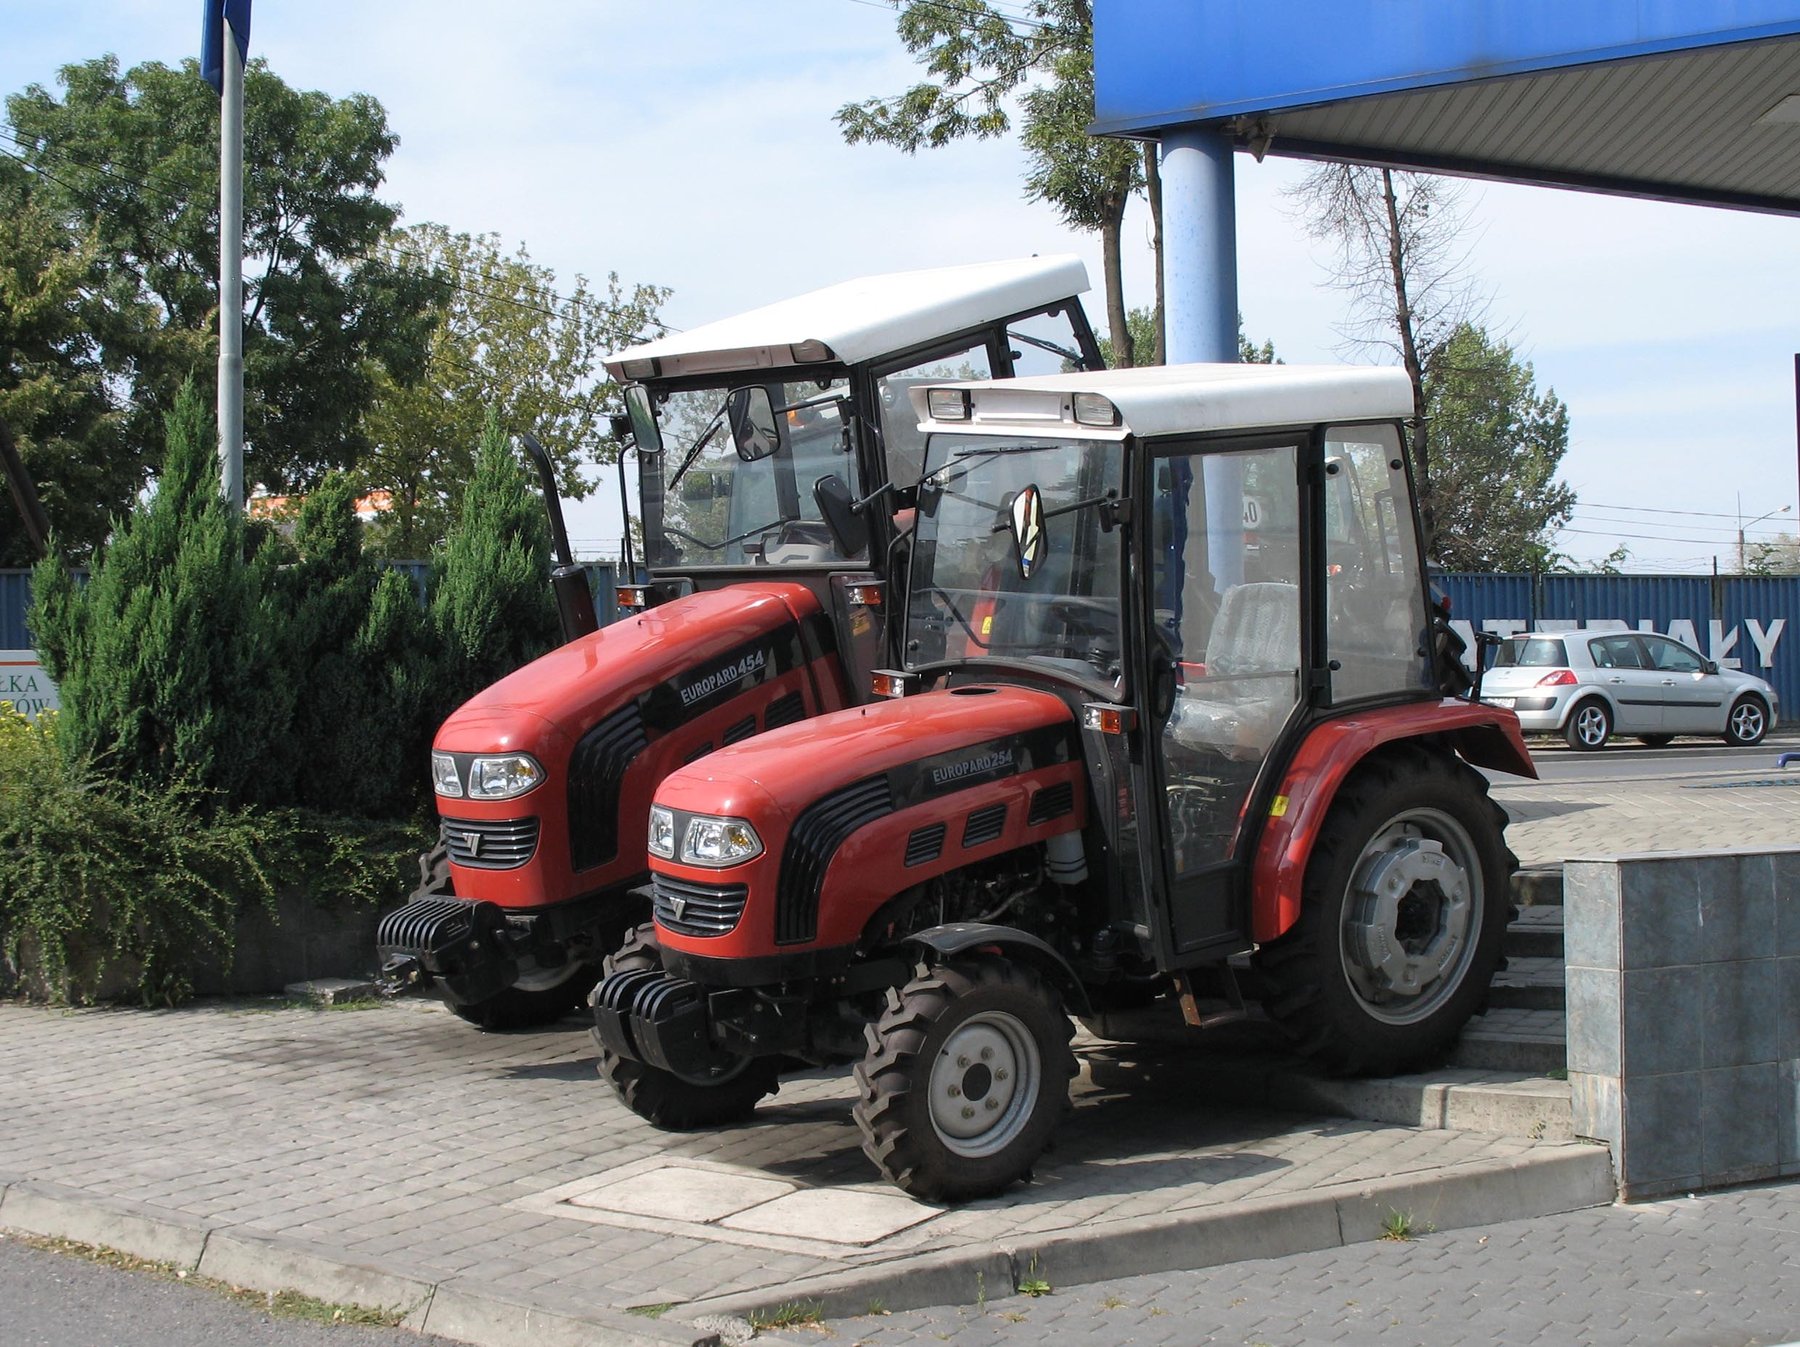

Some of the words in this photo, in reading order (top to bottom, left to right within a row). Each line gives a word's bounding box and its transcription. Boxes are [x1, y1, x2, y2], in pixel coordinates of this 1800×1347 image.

[680, 665, 738, 704] EUROPARD
[738, 650, 764, 674] 454
[9, 693, 50, 715] ÓW
[933, 756, 991, 782] EUROPARD
[990, 748, 1013, 767] 254
